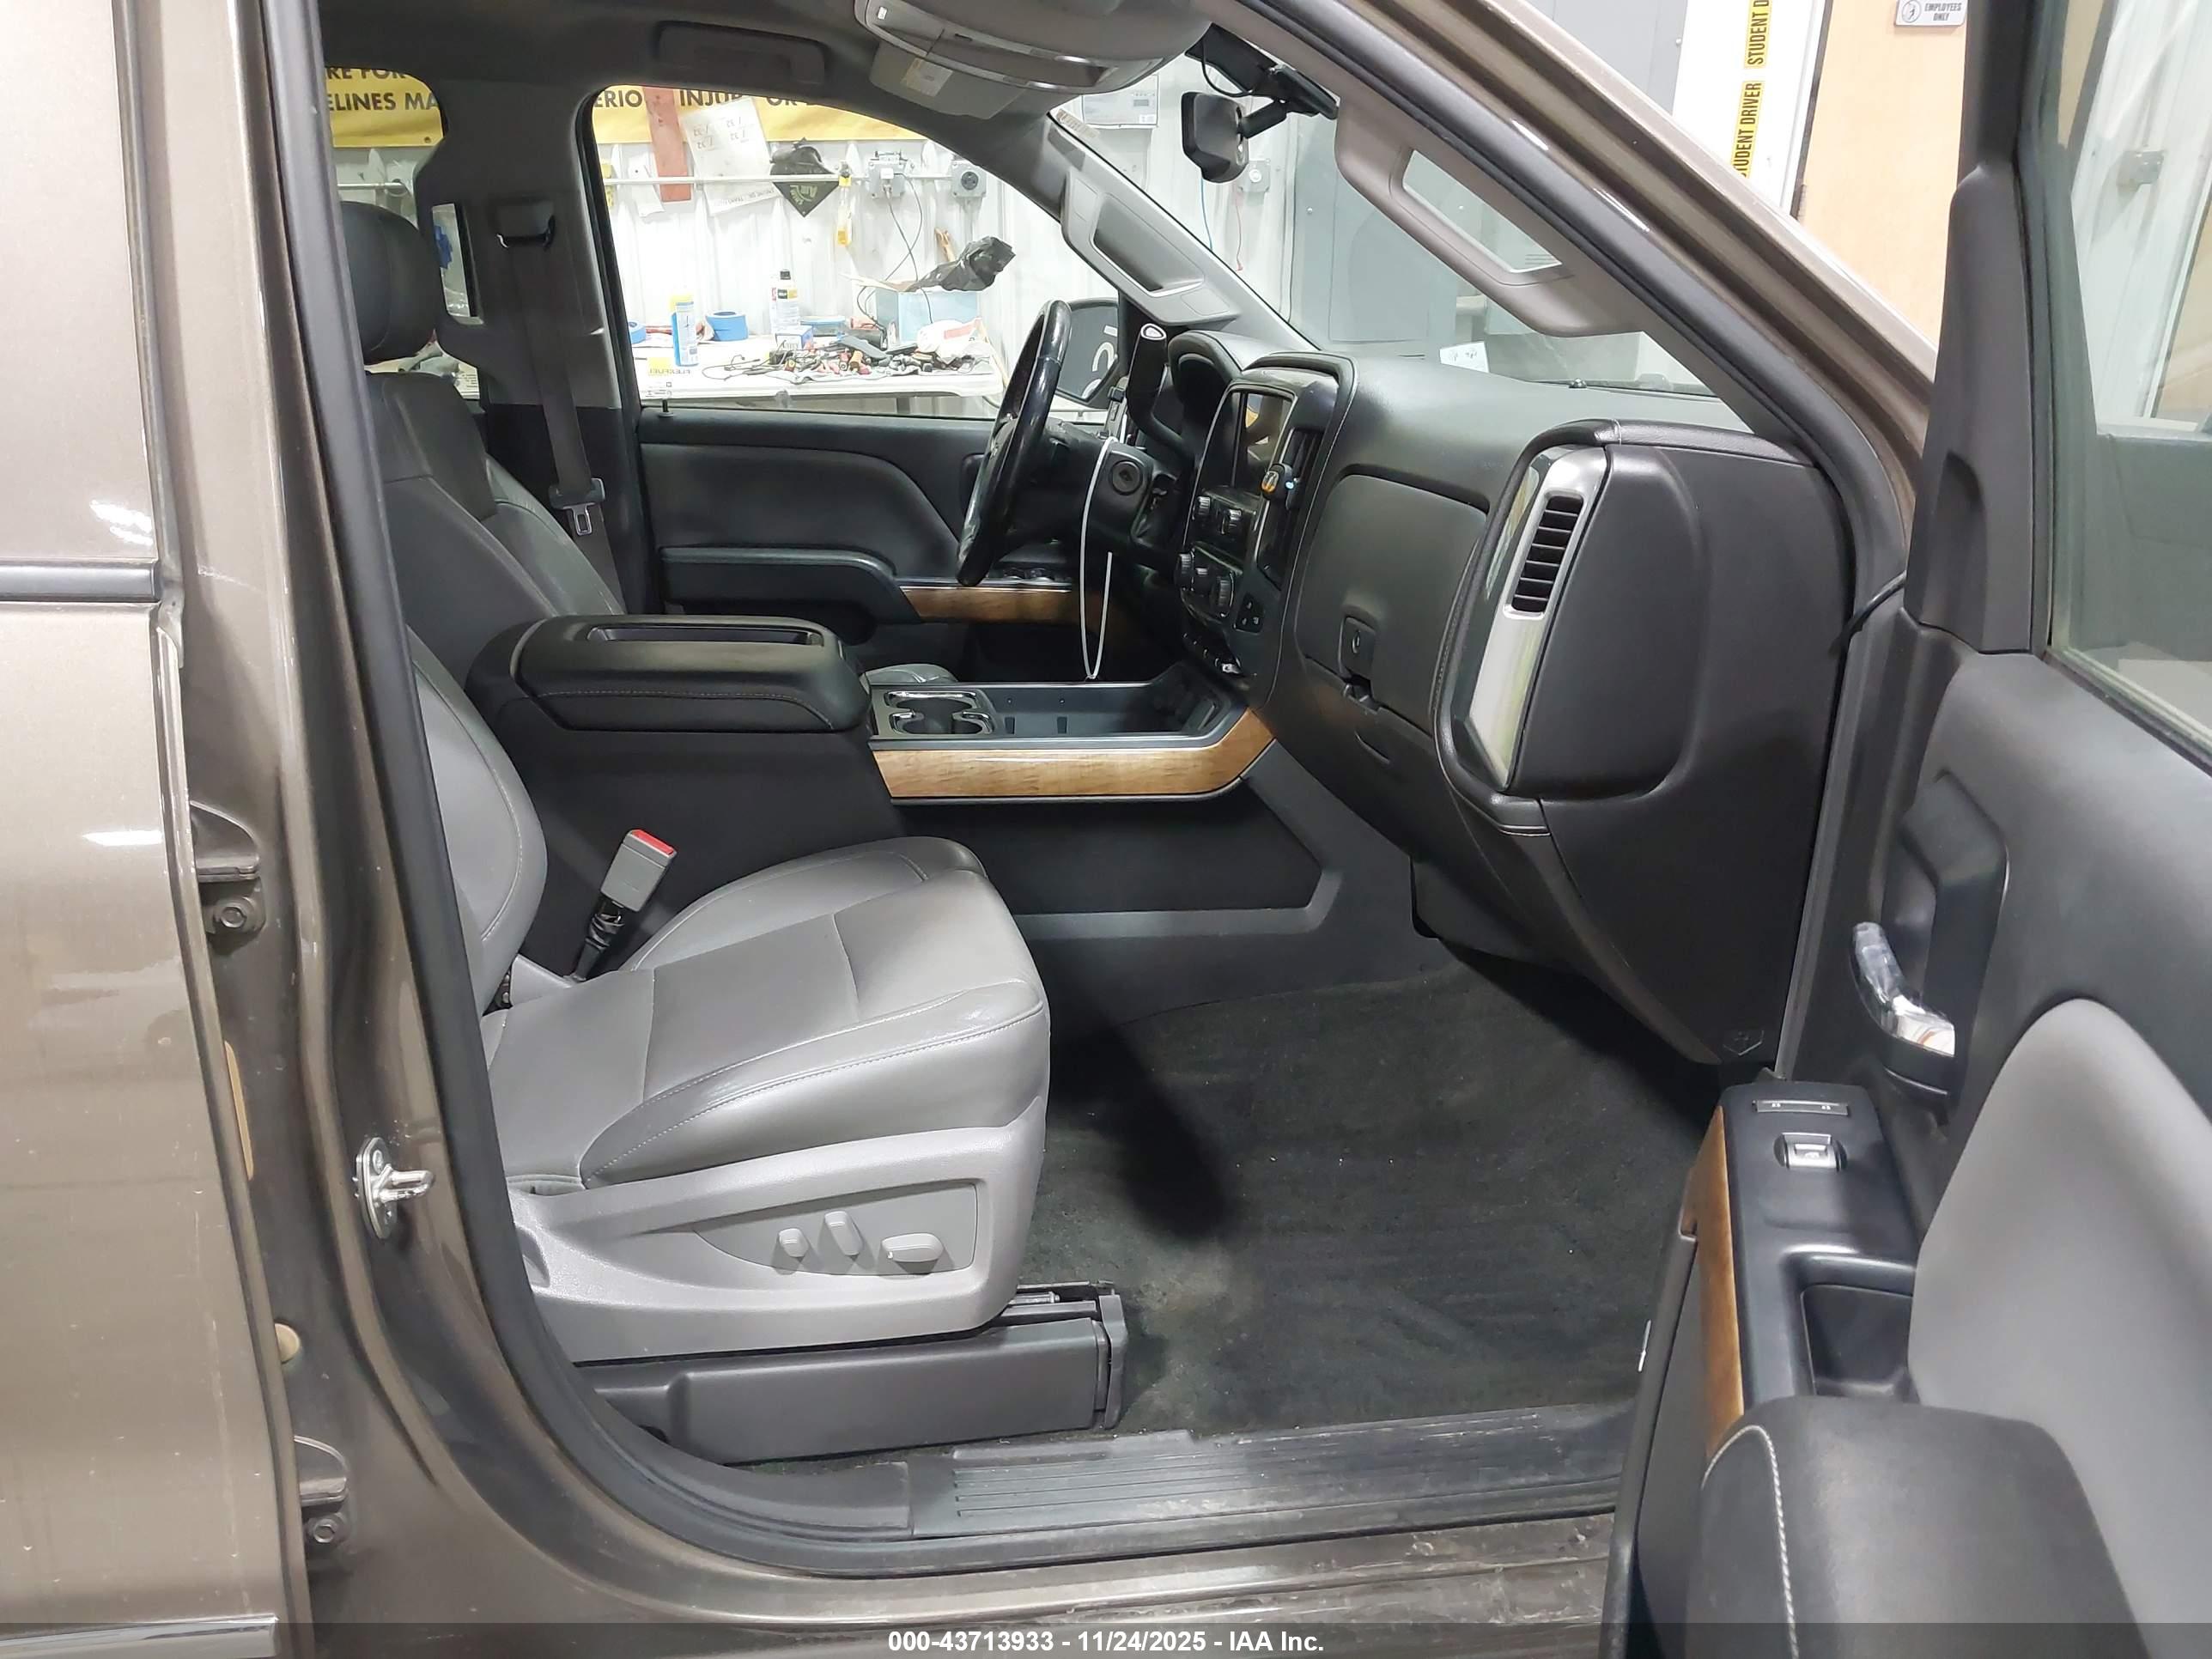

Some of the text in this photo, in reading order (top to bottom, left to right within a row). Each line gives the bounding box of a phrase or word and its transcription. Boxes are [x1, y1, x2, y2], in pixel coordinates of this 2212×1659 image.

[1924, 3, 1962, 12] EMPLOYEES
[1933, 13, 1950, 21] ONLY
[1747, 11, 1769, 65] STUDENT
[1733, 82, 1762, 178] TUDENT DRIVER
